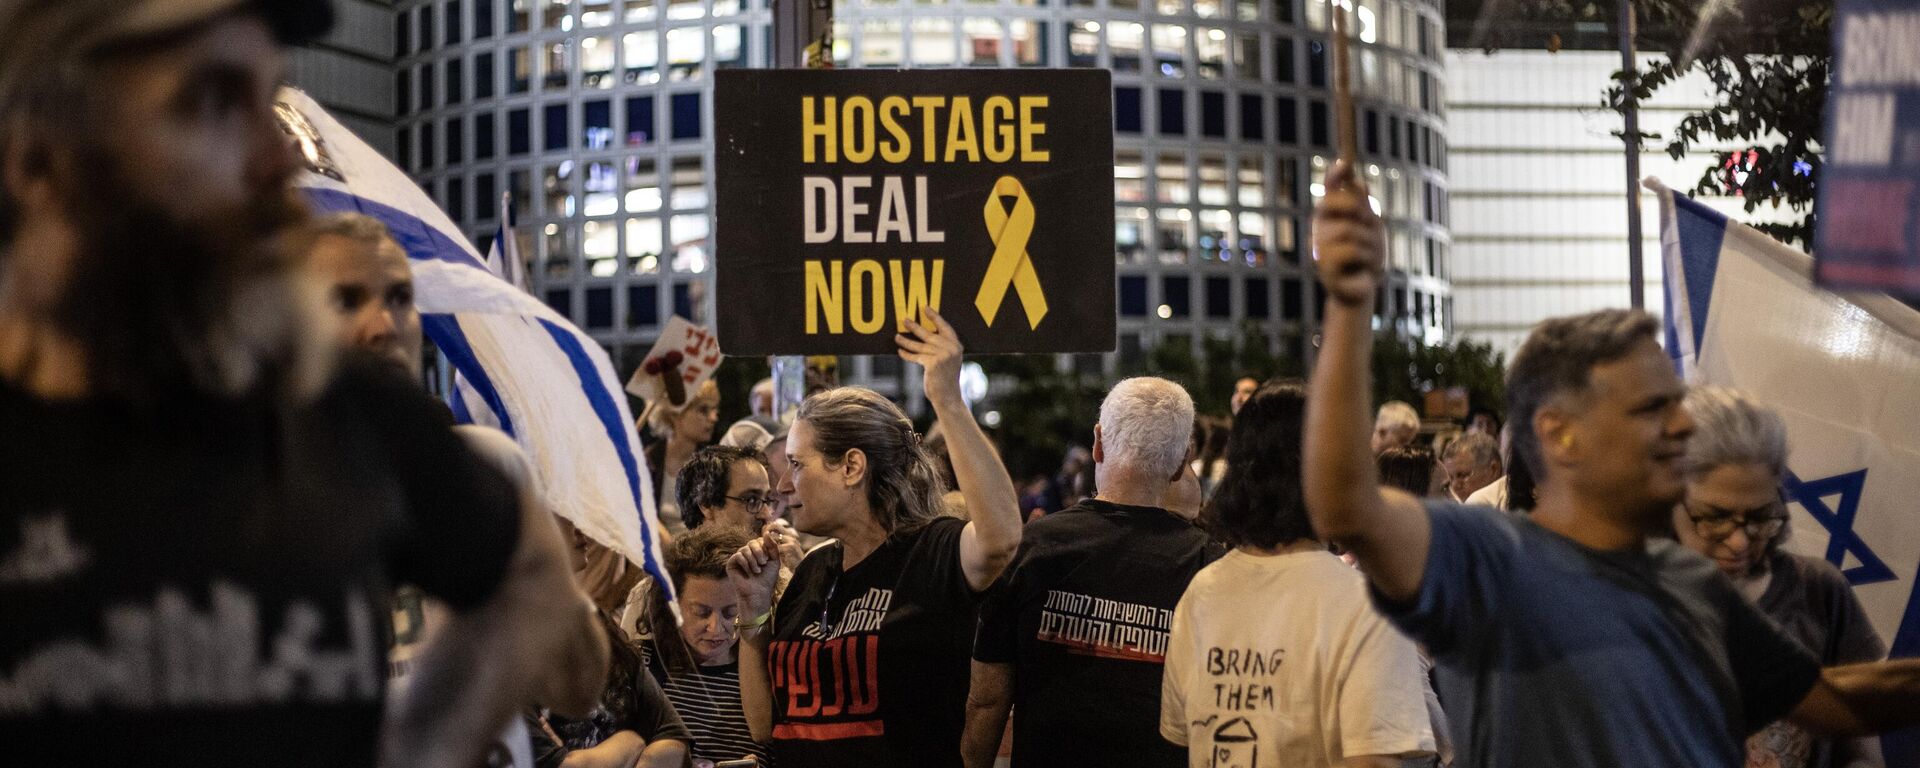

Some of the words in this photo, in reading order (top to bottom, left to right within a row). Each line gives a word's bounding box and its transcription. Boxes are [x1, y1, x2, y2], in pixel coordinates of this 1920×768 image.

[803, 96, 1050, 163] HOSTAGE
[804, 176, 945, 243] DEAL
[805, 259, 945, 334] NOW
[1044, 589, 1092, 616] להחזרת
[1091, 597, 1157, 627] המשפחות
[1038, 610, 1111, 647] והנעדרים
[1207, 647, 1286, 677] BRING
[1214, 683, 1274, 711] THEM
